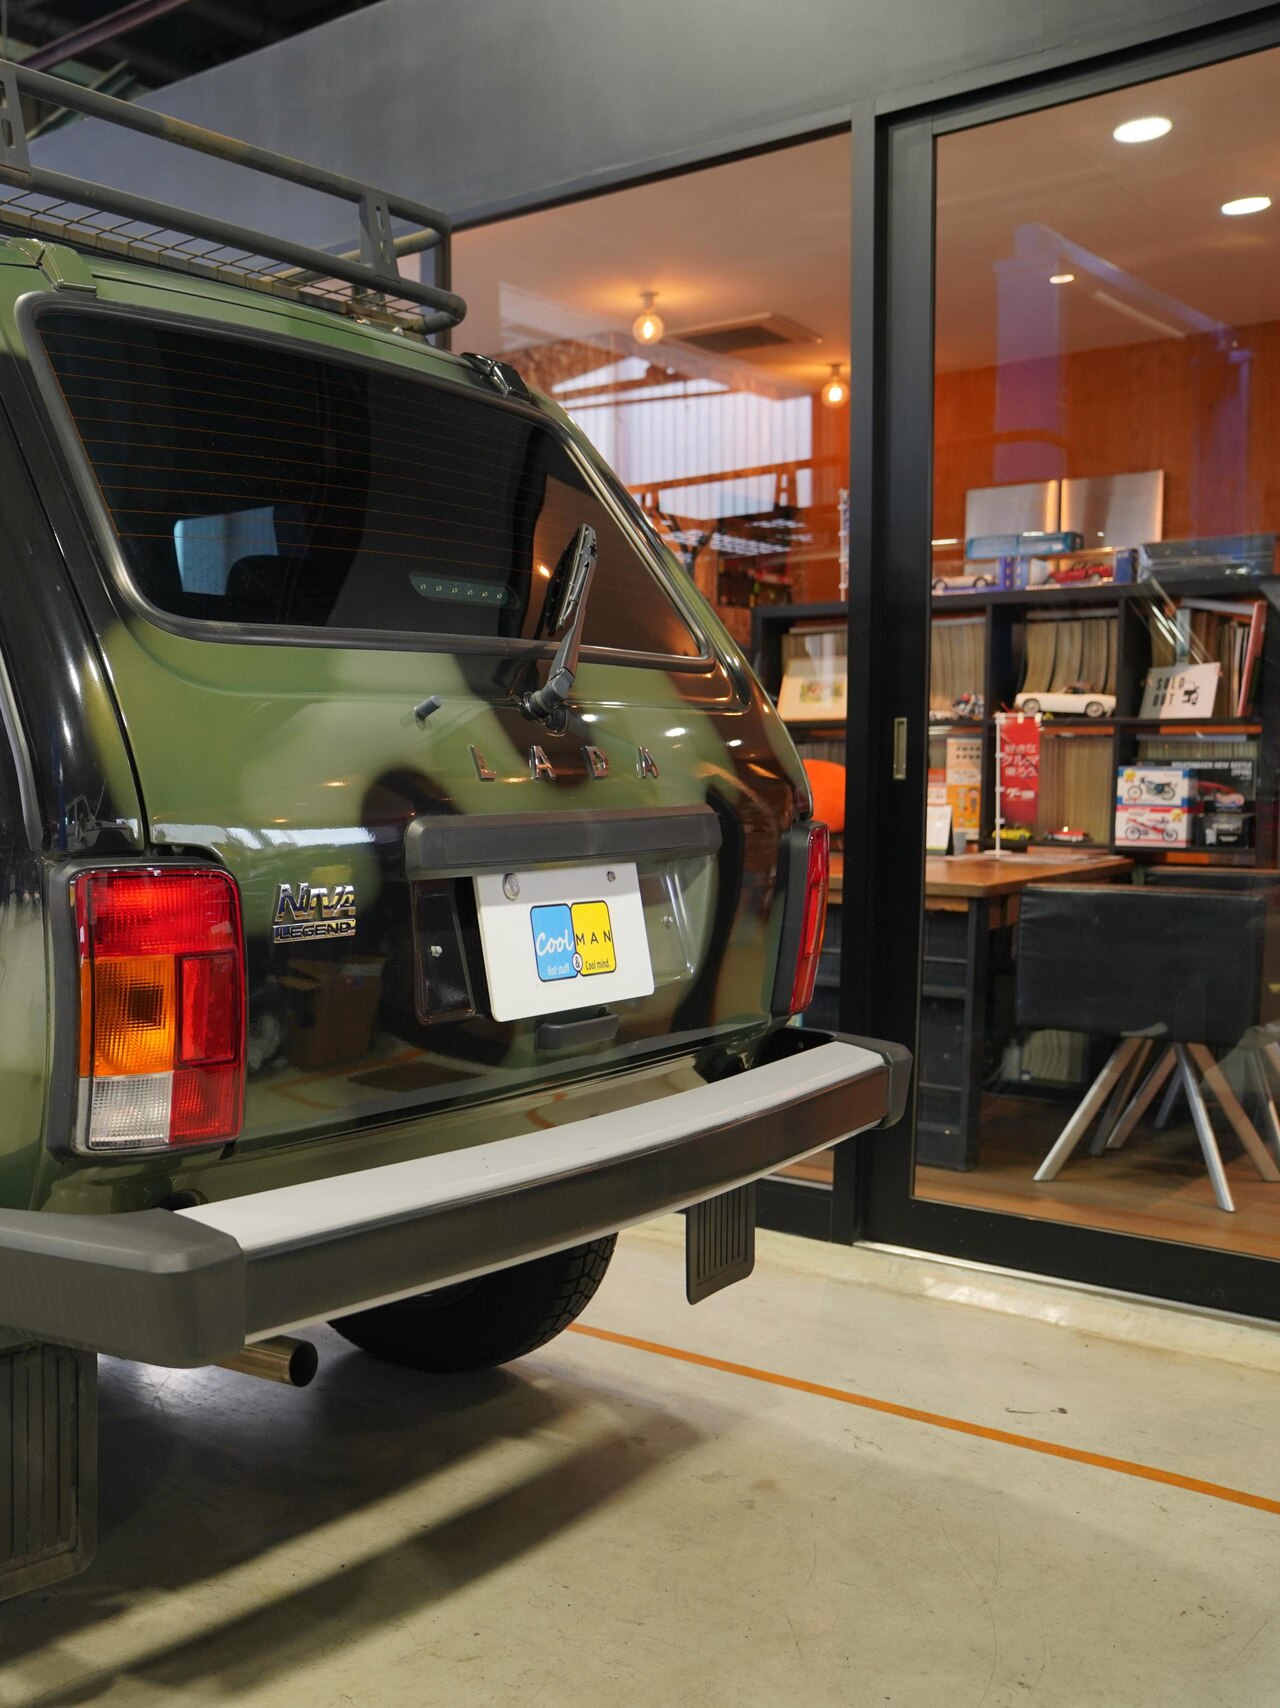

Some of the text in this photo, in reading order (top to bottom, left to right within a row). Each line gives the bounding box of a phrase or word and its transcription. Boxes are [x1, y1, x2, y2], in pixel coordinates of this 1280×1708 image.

[1156, 677, 1185, 691] SOLD
[1152, 693, 1175, 708] OUT
[467, 744, 660, 782] LADA
[277, 922, 351, 939] LEGEND
[536, 928, 612, 957] Cool MAN
[547, 965, 558, 976] Hot
[557, 962, 570, 974] stuff
[585, 960, 596, 971] Cool
